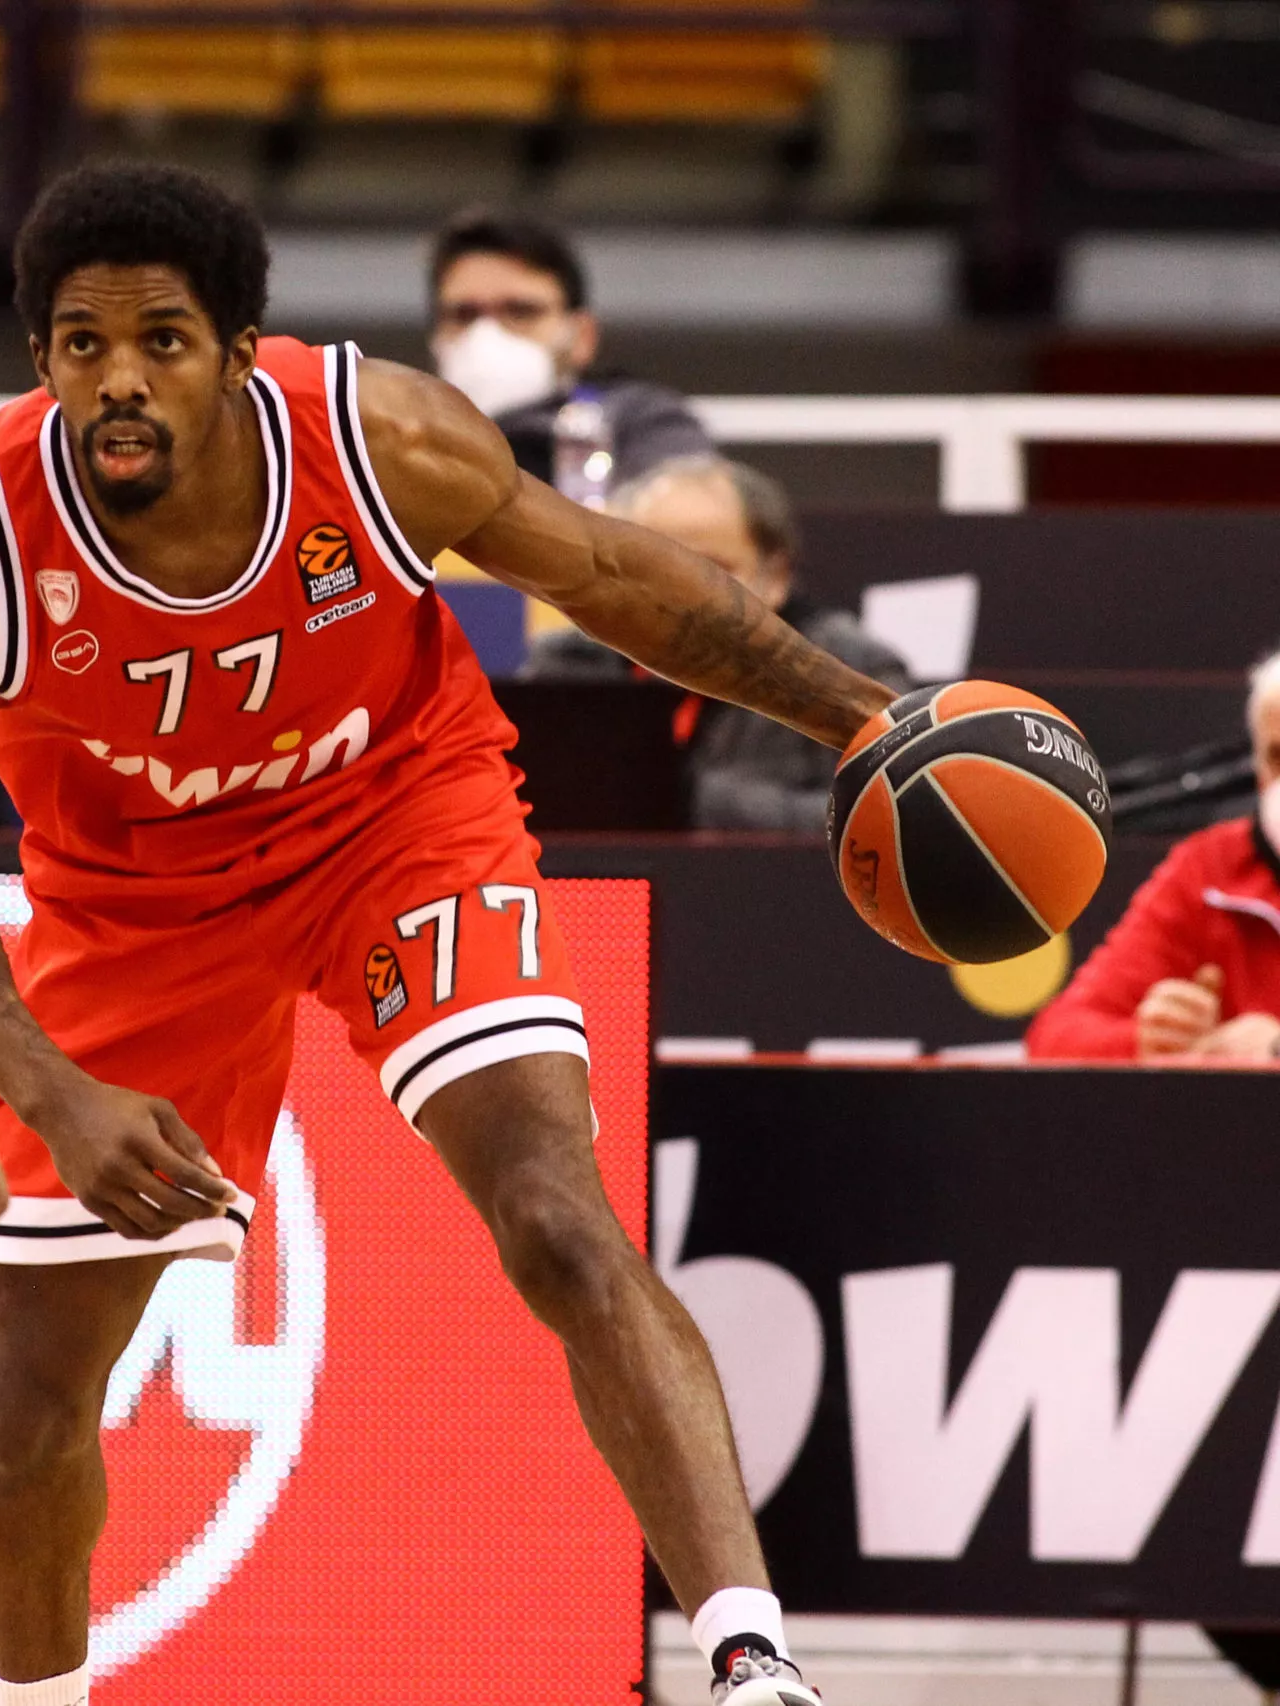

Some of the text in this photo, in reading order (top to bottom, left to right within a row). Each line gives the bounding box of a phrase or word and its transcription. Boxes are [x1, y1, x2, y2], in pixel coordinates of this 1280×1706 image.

[306, 593, 375, 631] oneteam
[308, 564, 354, 588] TURKISH
[125, 629, 282, 735] 77
[81, 706, 370, 808] win
[393, 883, 541, 1008] 77
[653, 1136, 1280, 1567] bw
